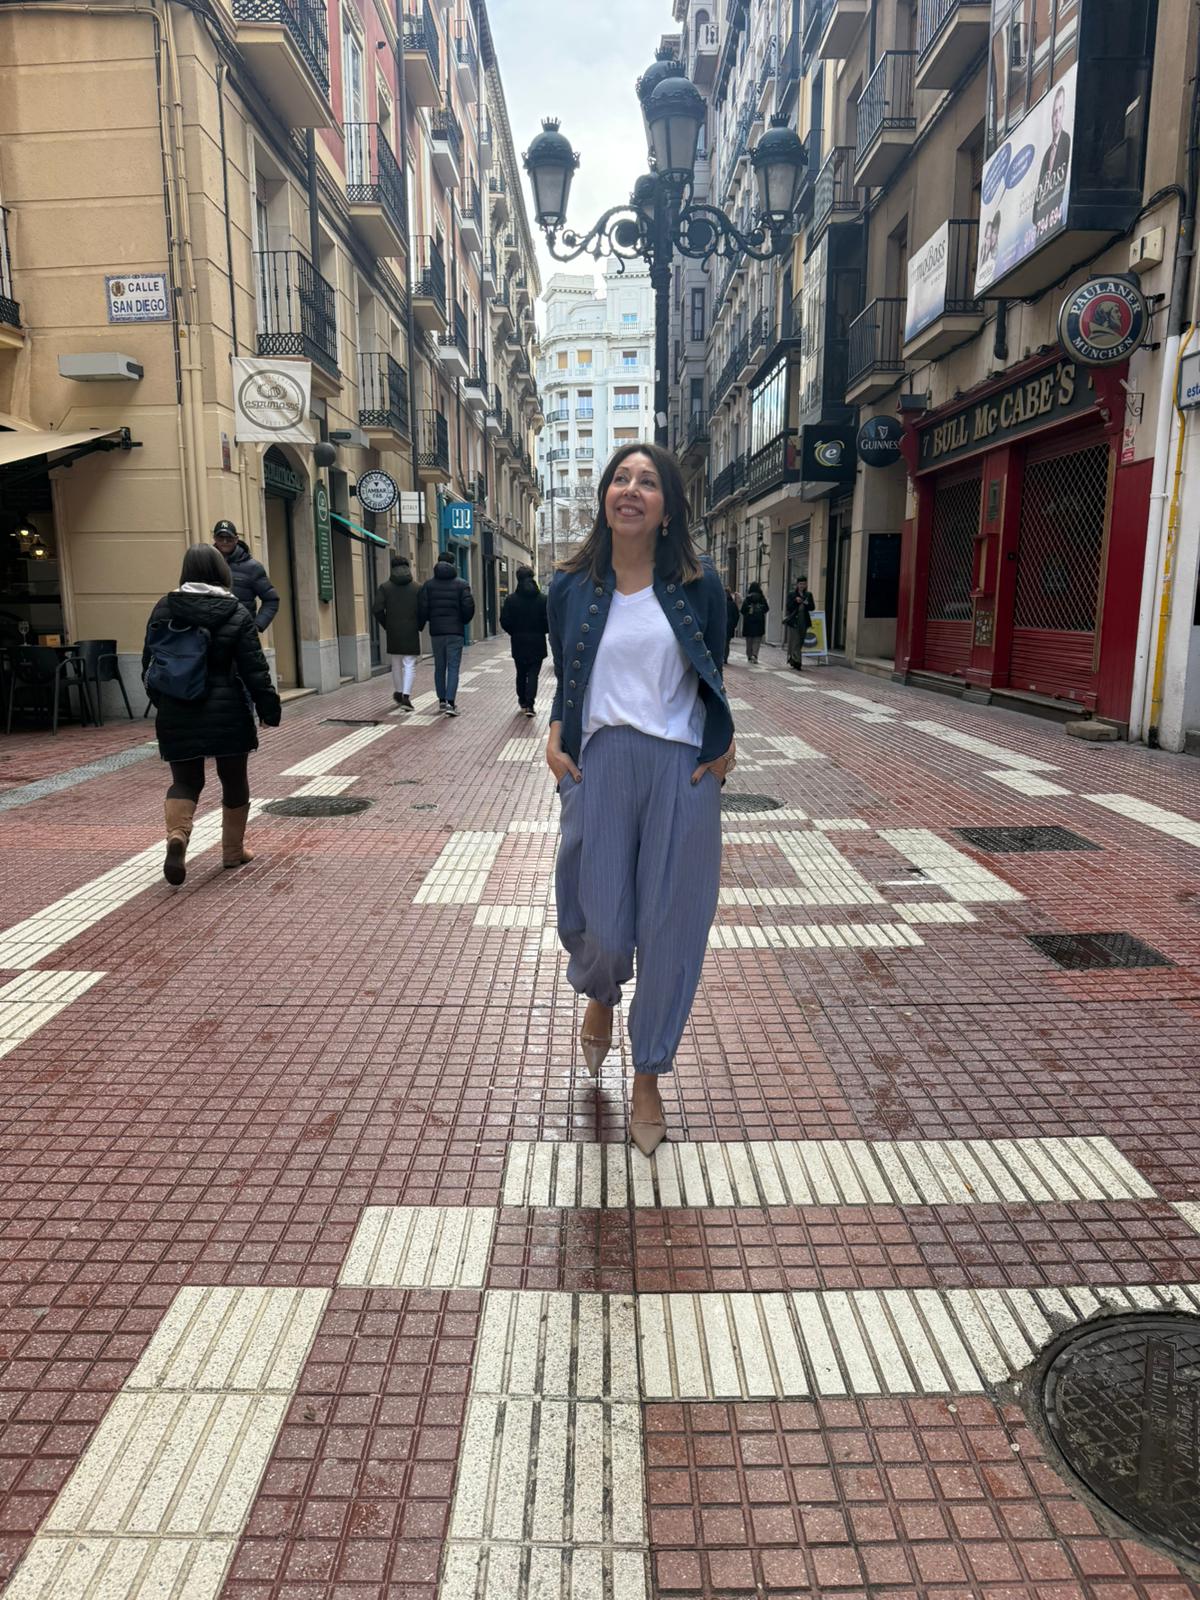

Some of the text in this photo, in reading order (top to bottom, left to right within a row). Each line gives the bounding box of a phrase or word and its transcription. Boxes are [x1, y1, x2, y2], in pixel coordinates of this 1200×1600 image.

[128, 281, 160, 292] CALLE
[113, 298, 165, 313] SAN DIEGO
[1070, 282, 1141, 314] PAULANER
[1187, 382, 1200, 398] est
[932, 414, 968, 458] BULL
